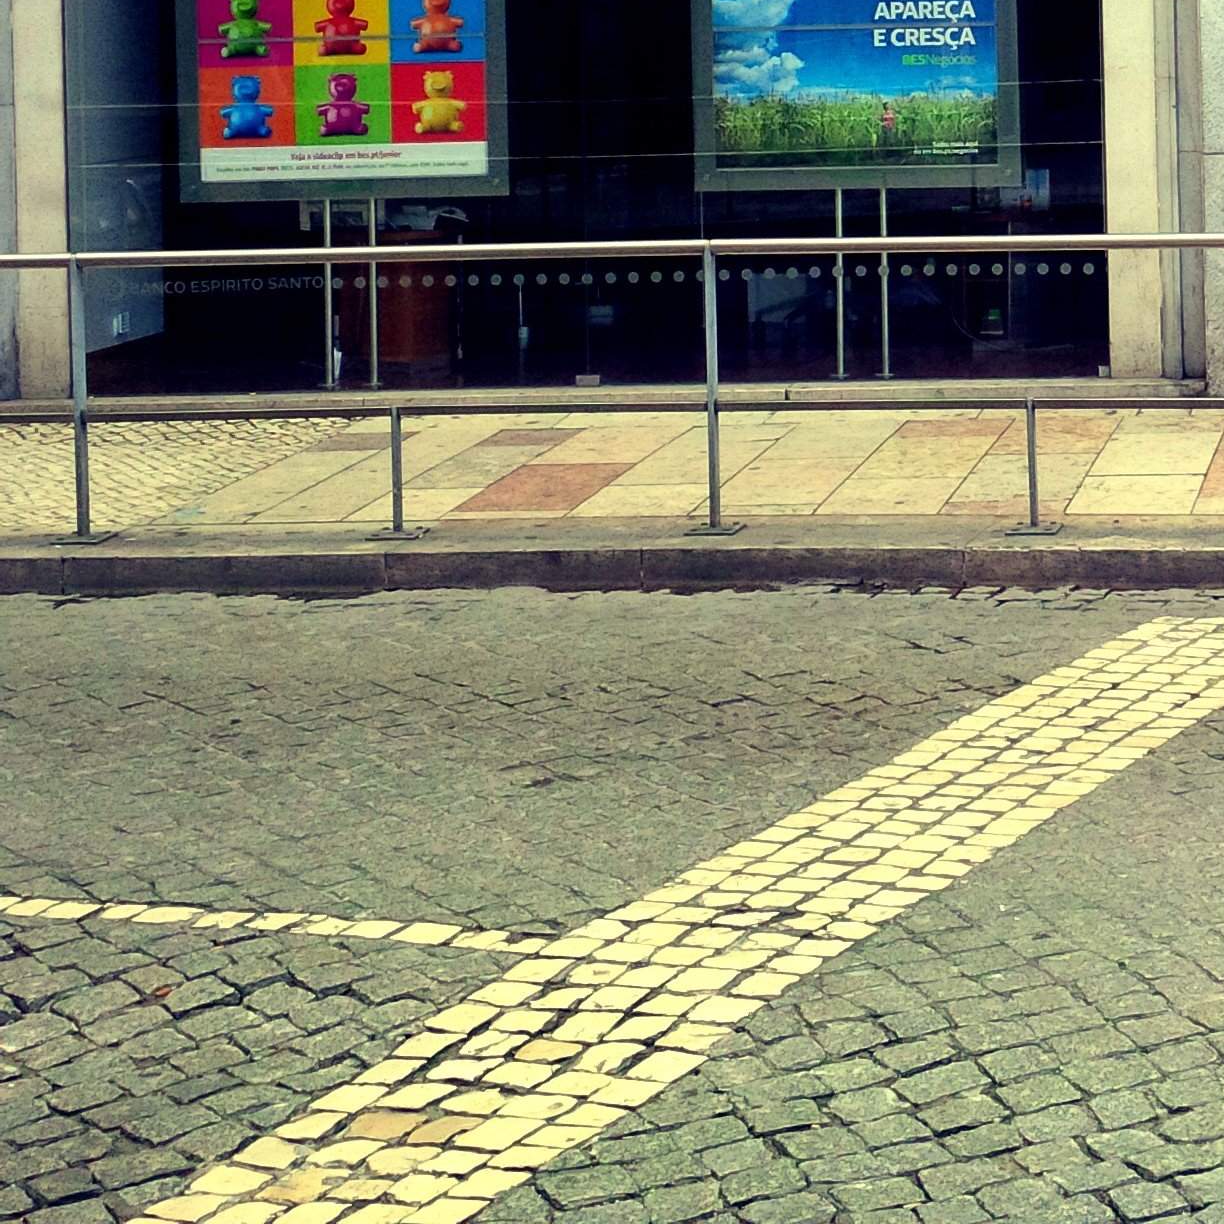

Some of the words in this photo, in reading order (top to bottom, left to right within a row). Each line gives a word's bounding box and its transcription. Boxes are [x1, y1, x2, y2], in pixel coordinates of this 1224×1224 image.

[874, 0, 976, 23] APAREÇA
[873, 28, 886, 47] E
[890, 26, 976, 50] CRESÇA
[191, 278, 263, 293] ESPIRITO
[267, 277, 323, 290] SANTO
